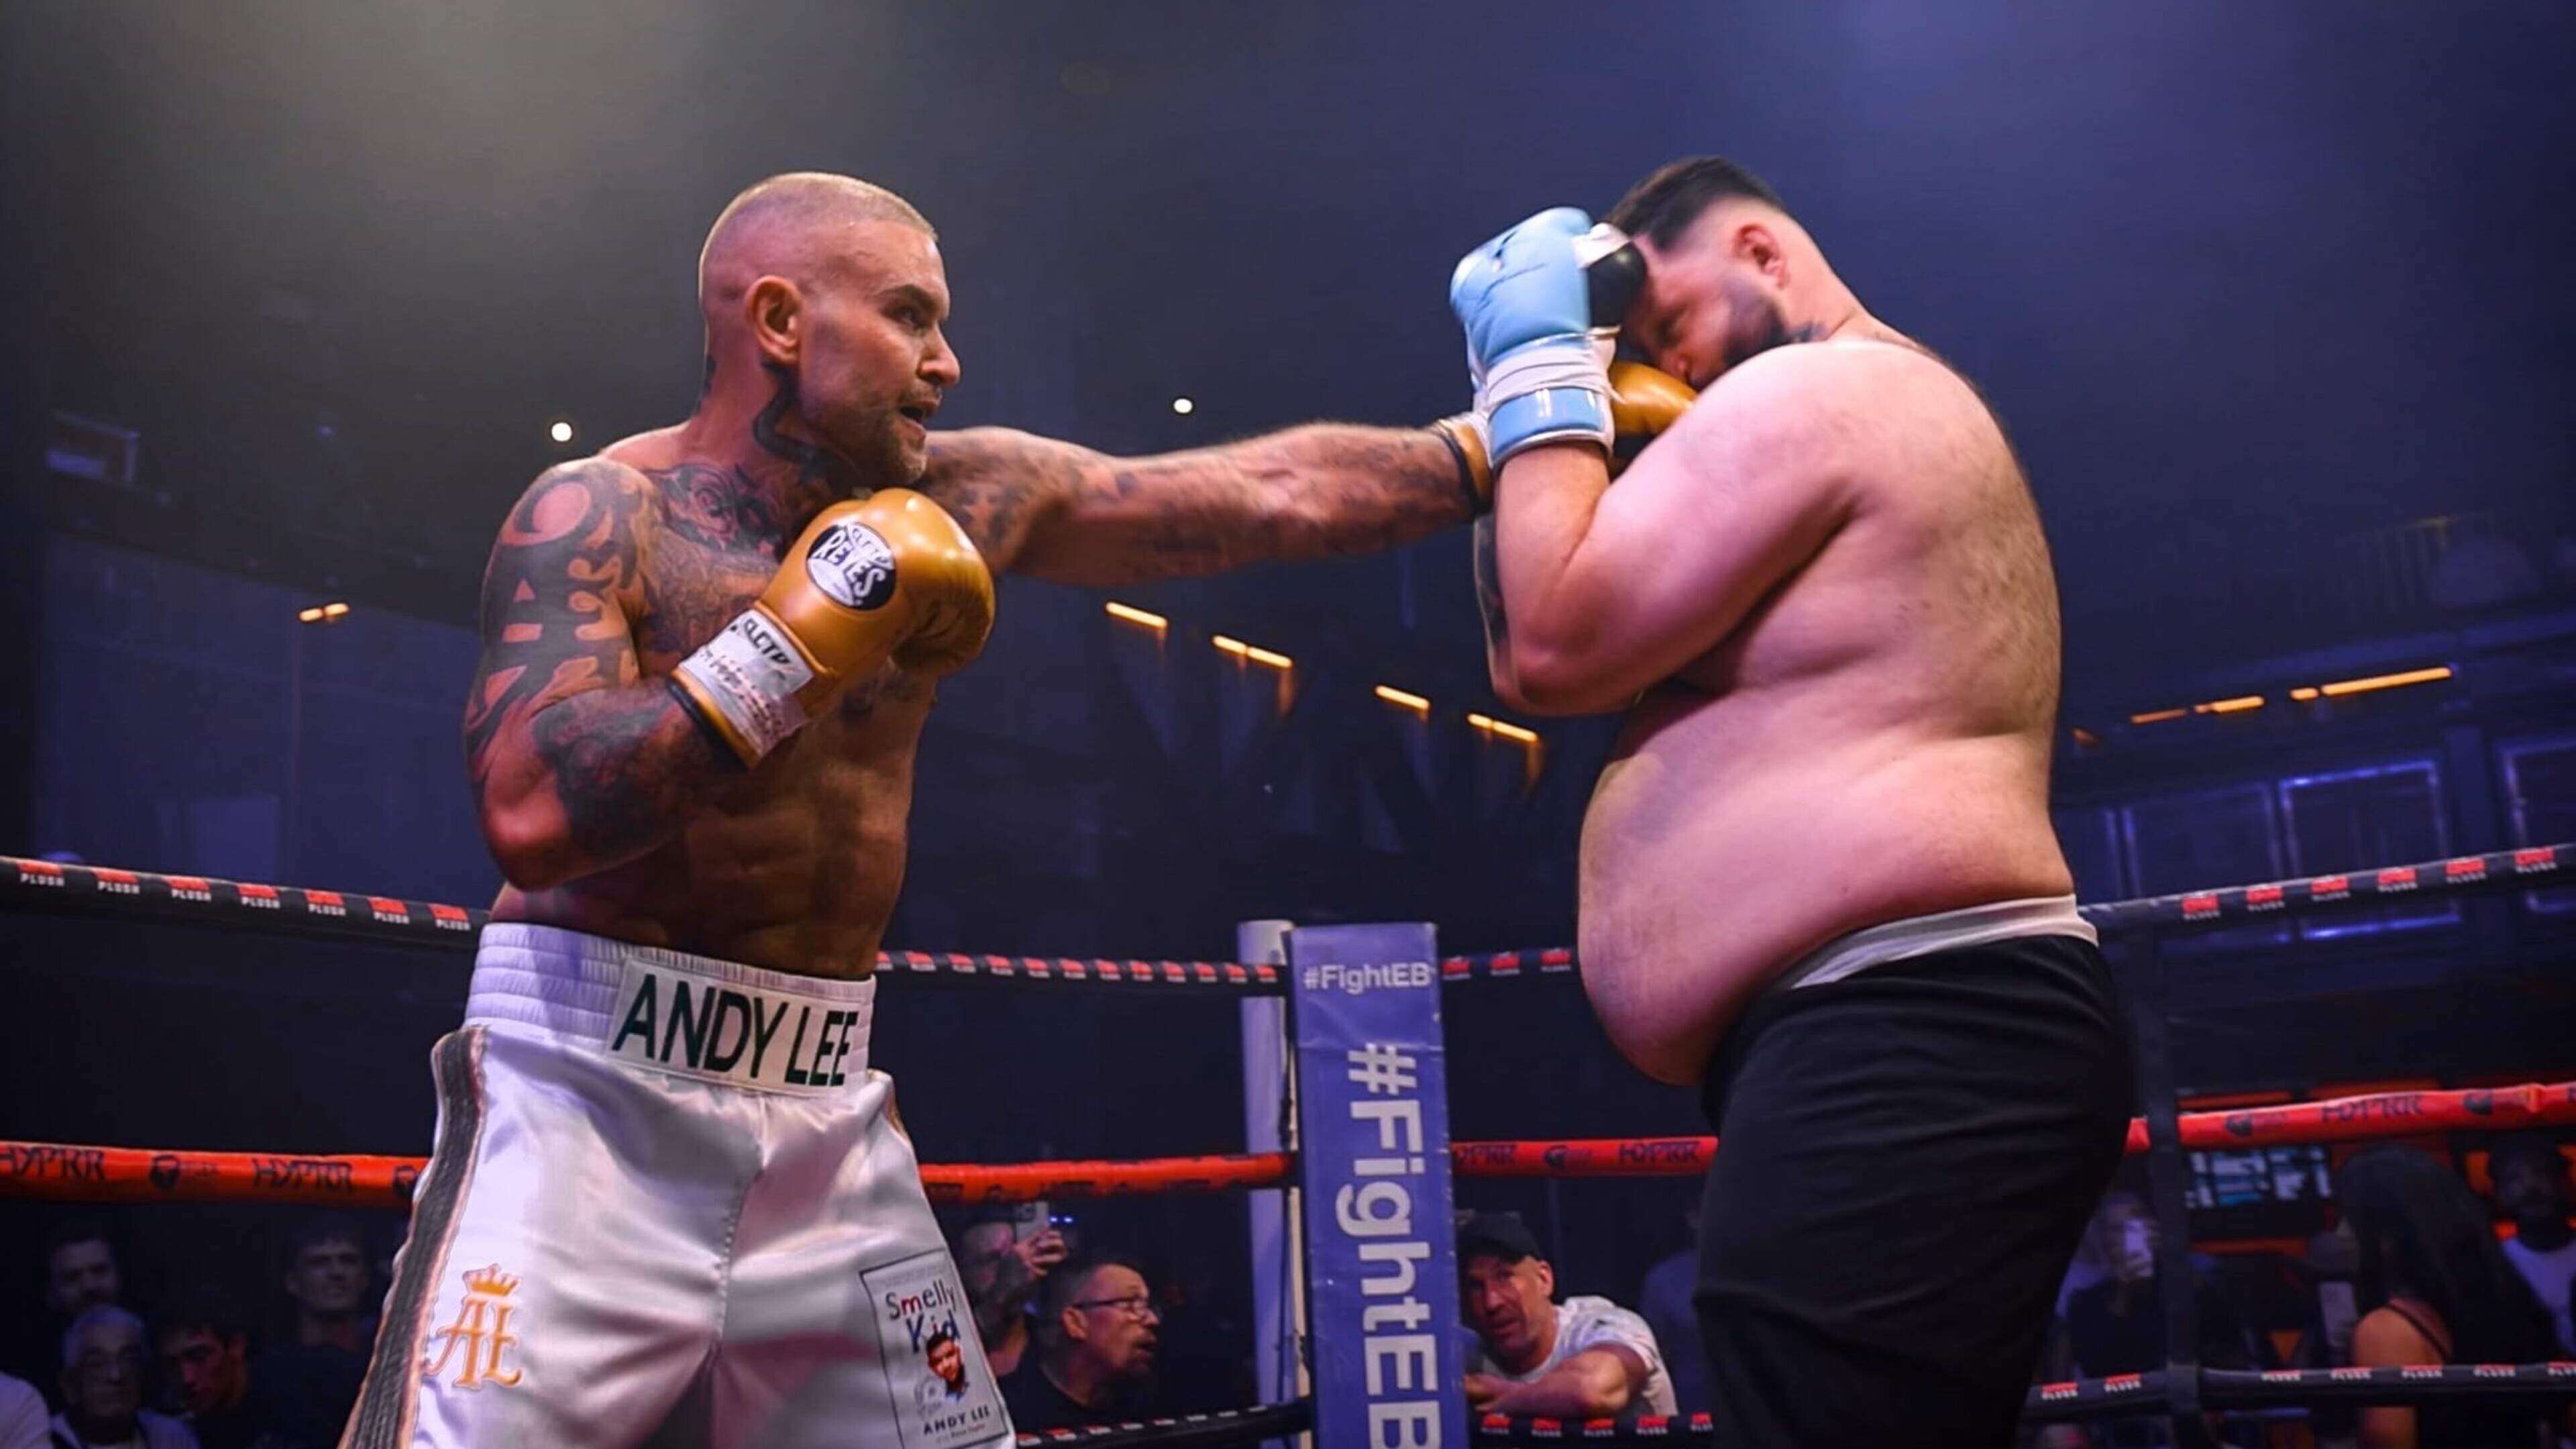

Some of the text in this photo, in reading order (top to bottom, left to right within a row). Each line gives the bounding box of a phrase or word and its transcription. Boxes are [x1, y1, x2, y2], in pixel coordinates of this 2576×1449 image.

[810, 526, 887, 598] REYES
[1305, 961, 1431, 995] #FightEB
[612, 973, 859, 1086] ANDY LEE
[1336, 1042, 1441, 1449] #FightEB
[885, 1279, 957, 1320] Smelly
[923, 1411, 965, 1436] ANDY
